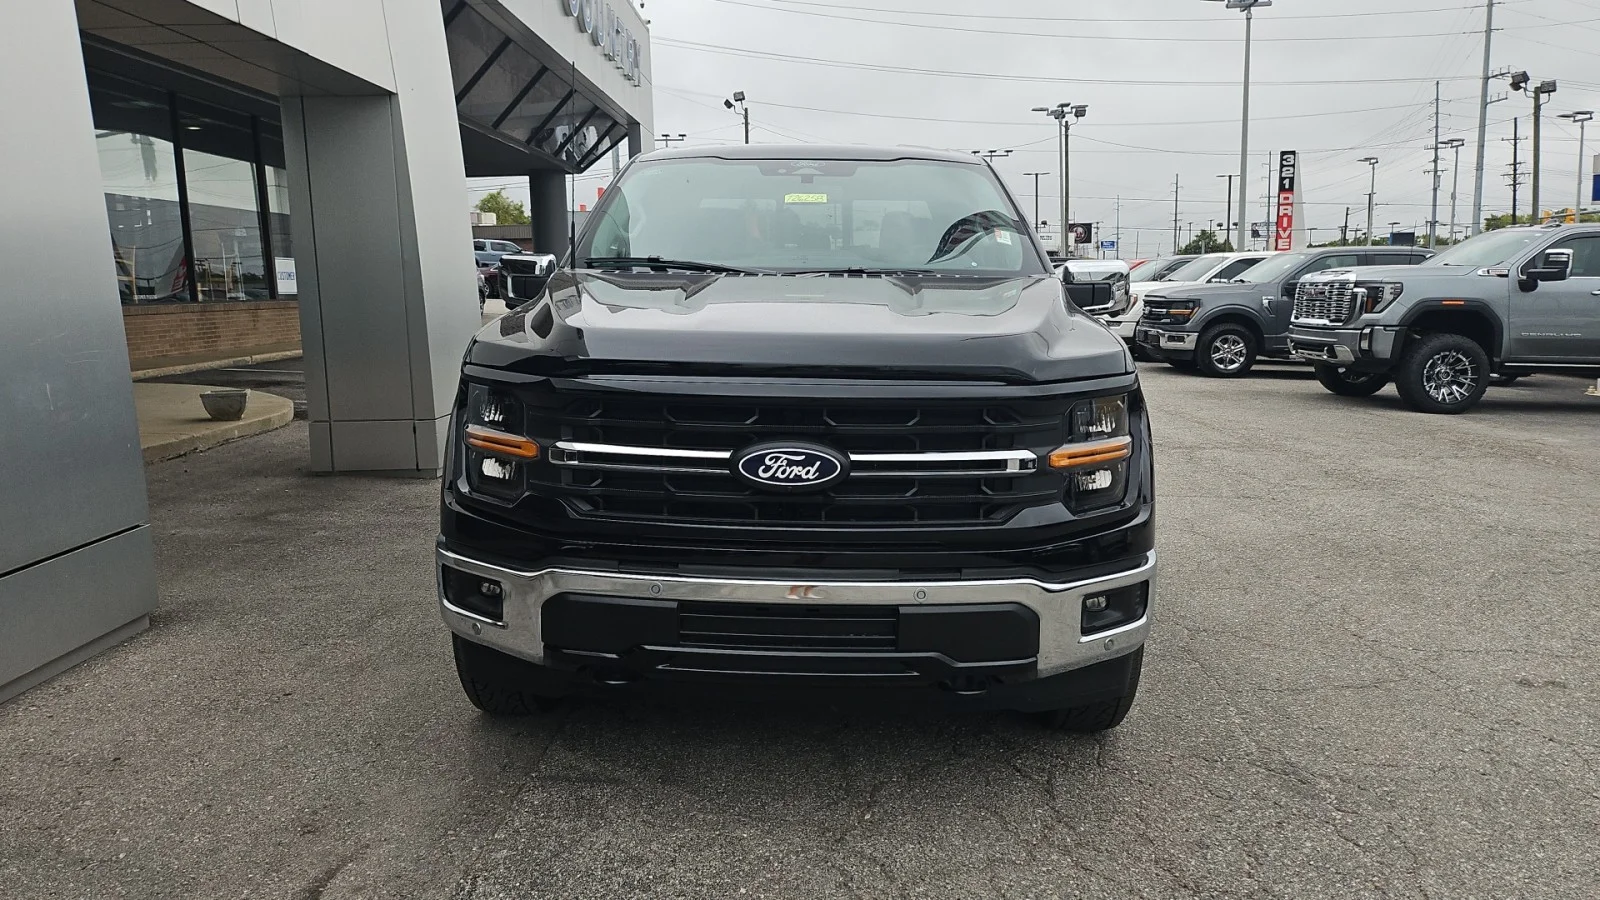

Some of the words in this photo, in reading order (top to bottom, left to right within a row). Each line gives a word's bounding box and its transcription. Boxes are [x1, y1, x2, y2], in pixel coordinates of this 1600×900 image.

[1281, 154, 1295, 189] 321
[1277, 193, 1294, 250] DRIVE
[758, 453, 821, 479] Ford
